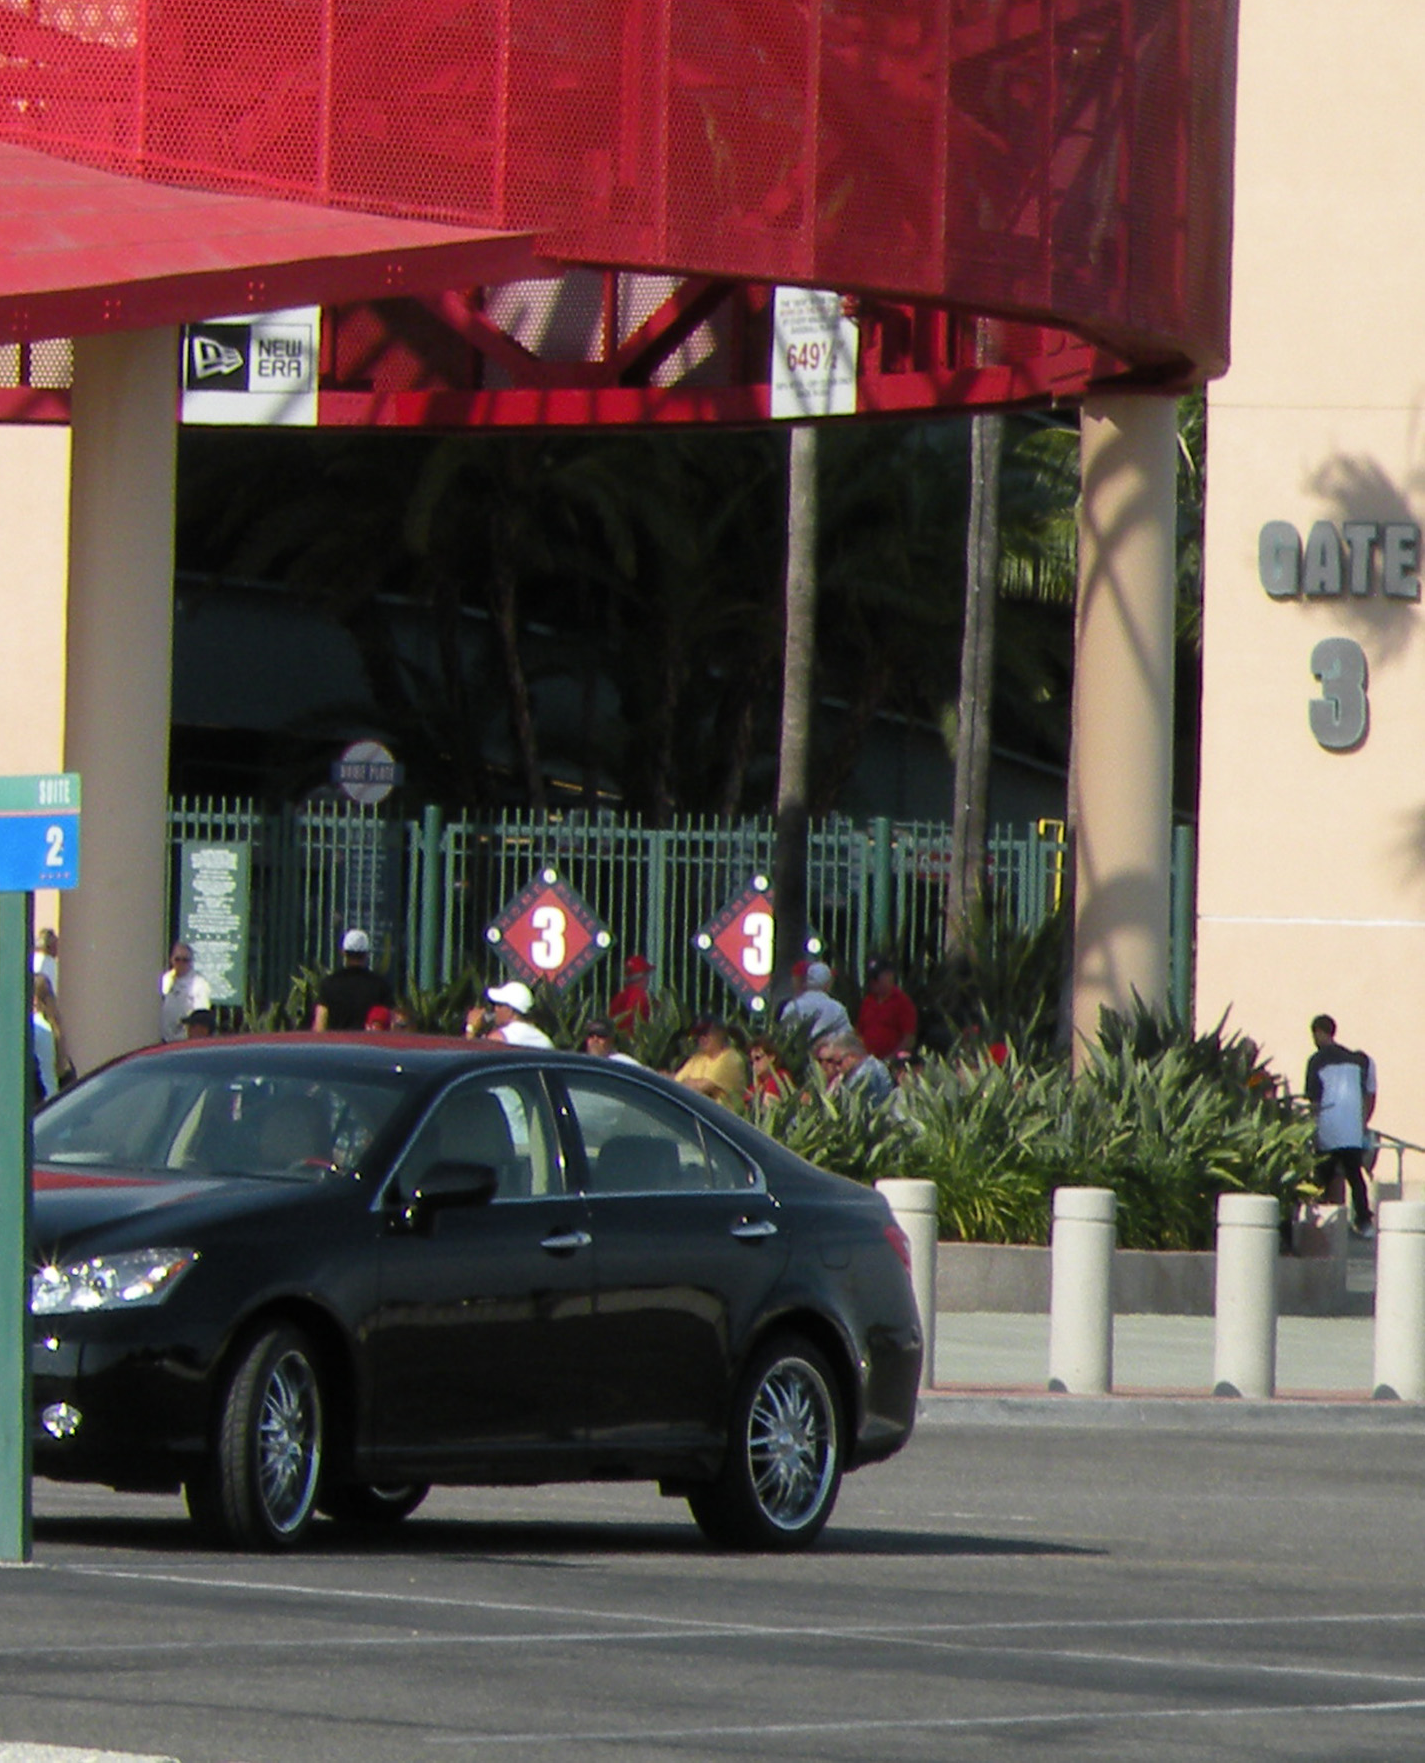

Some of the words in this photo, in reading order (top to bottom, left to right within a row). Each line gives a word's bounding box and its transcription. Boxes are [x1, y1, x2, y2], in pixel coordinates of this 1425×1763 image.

[258, 339, 303, 358] NEW
[258, 359, 302, 378] ERA
[1258, 520, 1421, 604] GATE
[1308, 637, 1370, 752] 3
[38, 778, 71, 805] SUITE
[45, 825, 64, 867] 2
[531, 906, 566, 969] 3
[742, 912, 774, 976] 3
